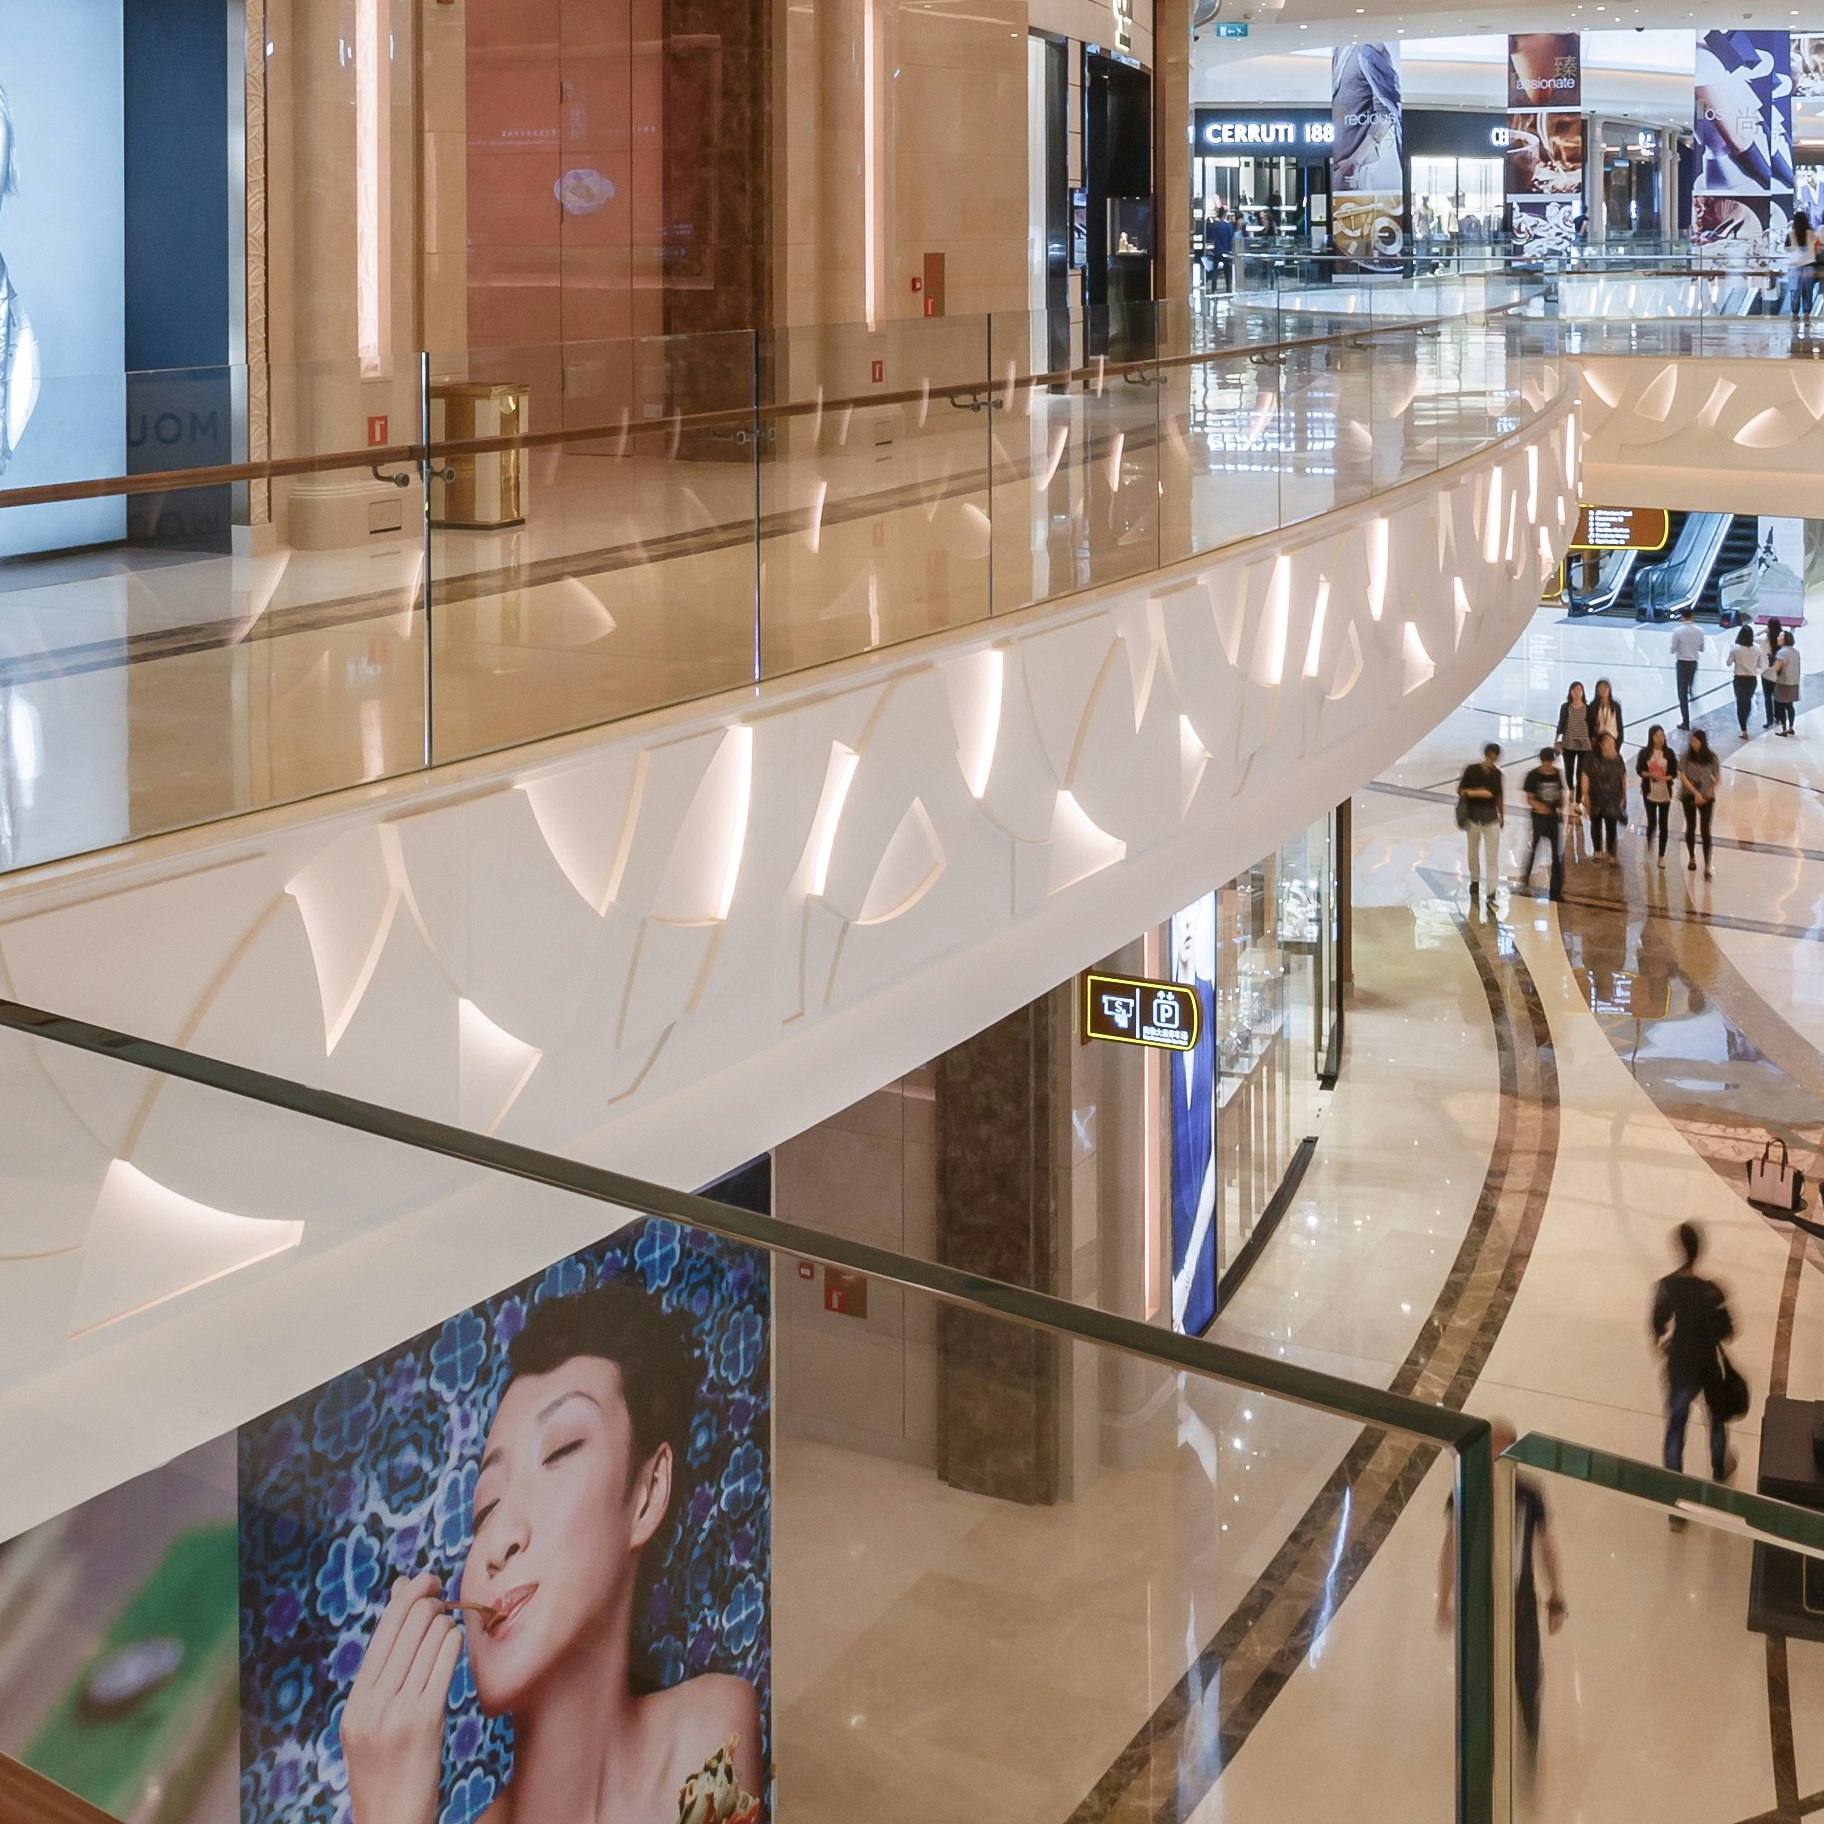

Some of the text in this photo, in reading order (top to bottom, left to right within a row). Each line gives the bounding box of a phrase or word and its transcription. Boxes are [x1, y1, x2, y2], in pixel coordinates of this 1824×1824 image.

[1516, 77, 1575, 90] assionate
[1344, 111, 1396, 126] recious
[1206, 124, 1335, 143] CERRUTI 188
